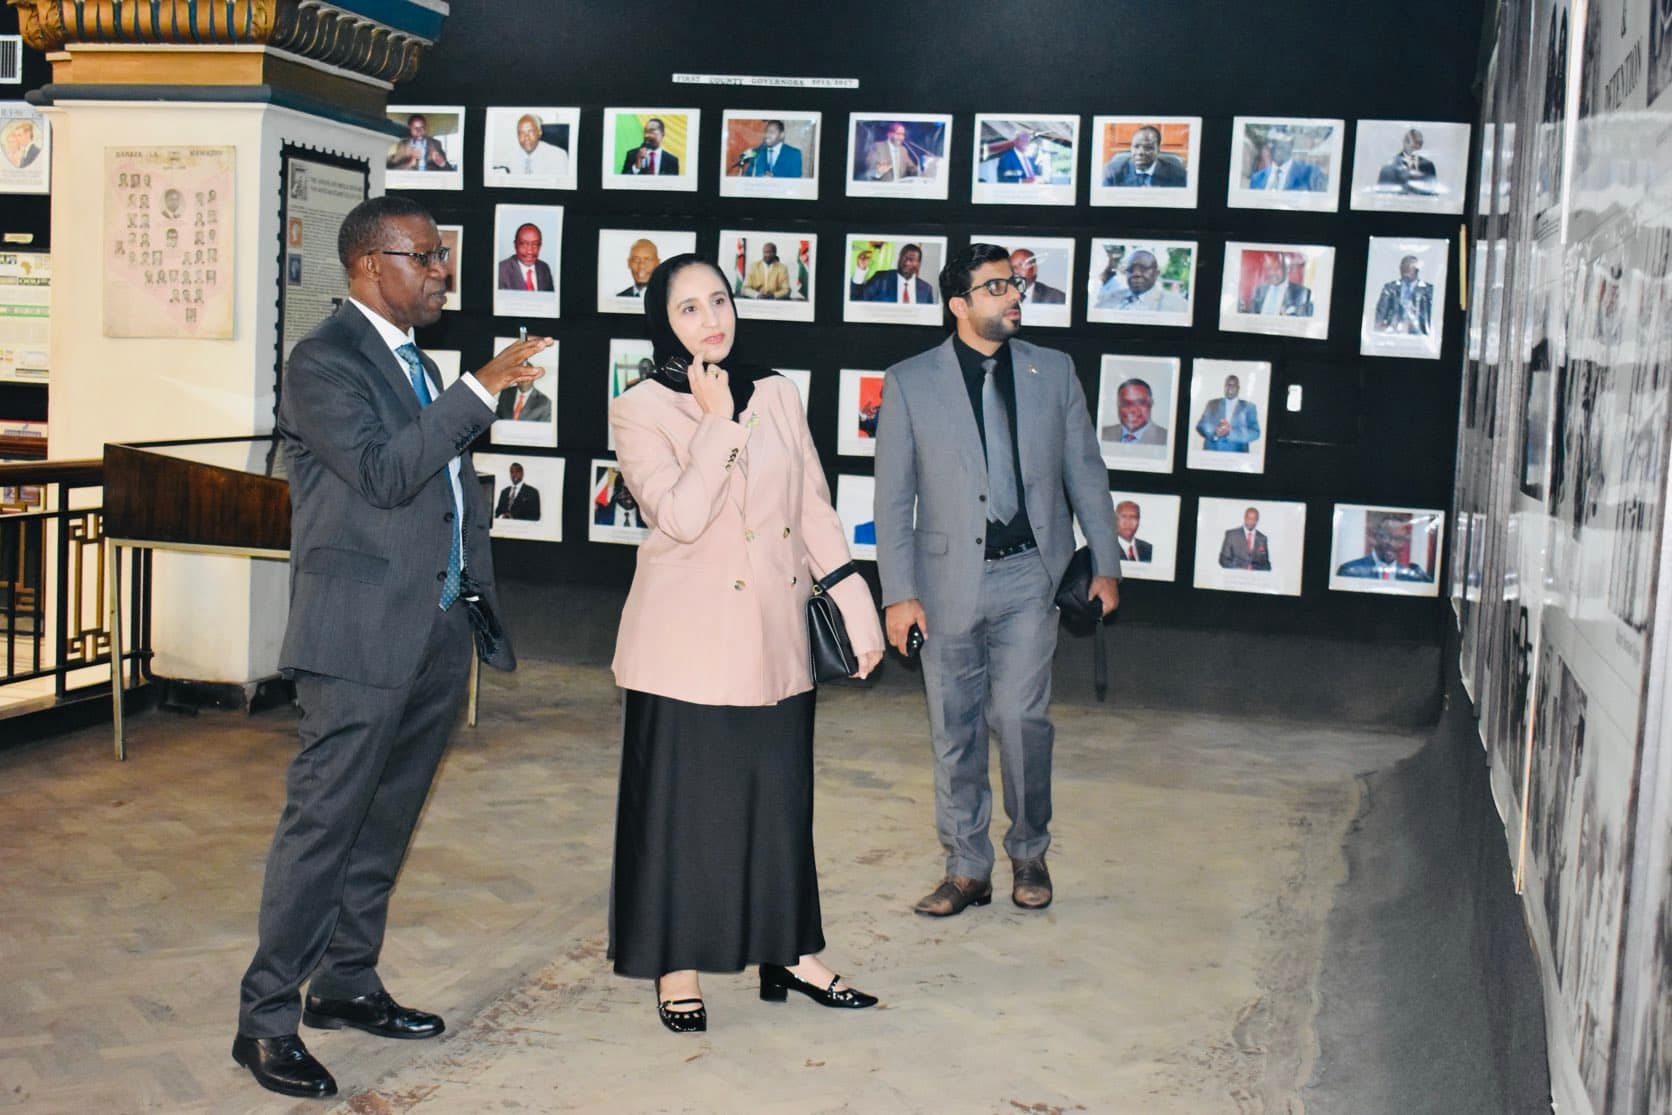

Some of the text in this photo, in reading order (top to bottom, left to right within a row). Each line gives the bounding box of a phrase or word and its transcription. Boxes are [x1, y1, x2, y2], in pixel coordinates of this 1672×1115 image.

[676, 75, 701, 83] FIRST
[709, 77, 744, 85] COUNTY
[751, 78, 805, 87] GOVERNORS
